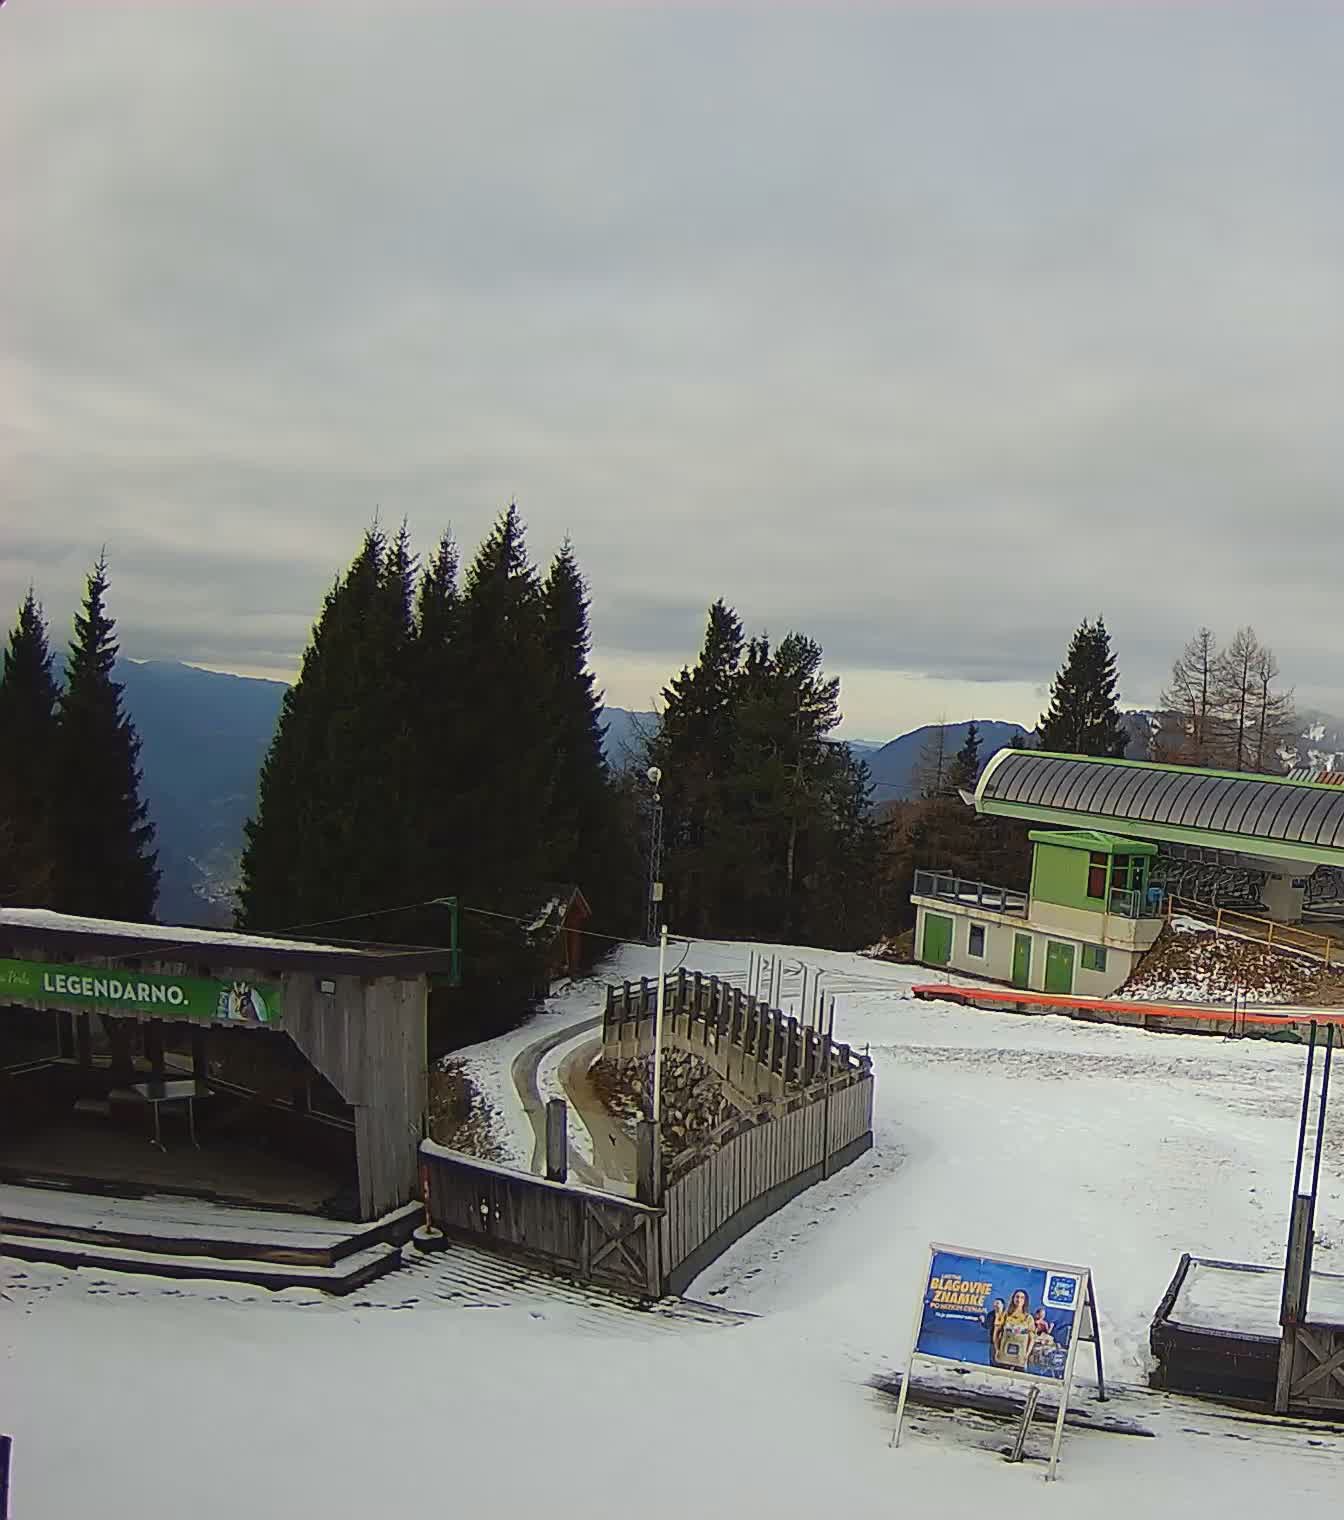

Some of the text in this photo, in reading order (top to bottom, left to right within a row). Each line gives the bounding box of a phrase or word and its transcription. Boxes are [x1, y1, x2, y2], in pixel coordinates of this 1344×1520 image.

[43, 973, 189, 1005] LEGENDARNO.
[930, 1277, 992, 1295] BLAGOVNE
[932, 1290, 985, 1307] ZNAMKE
